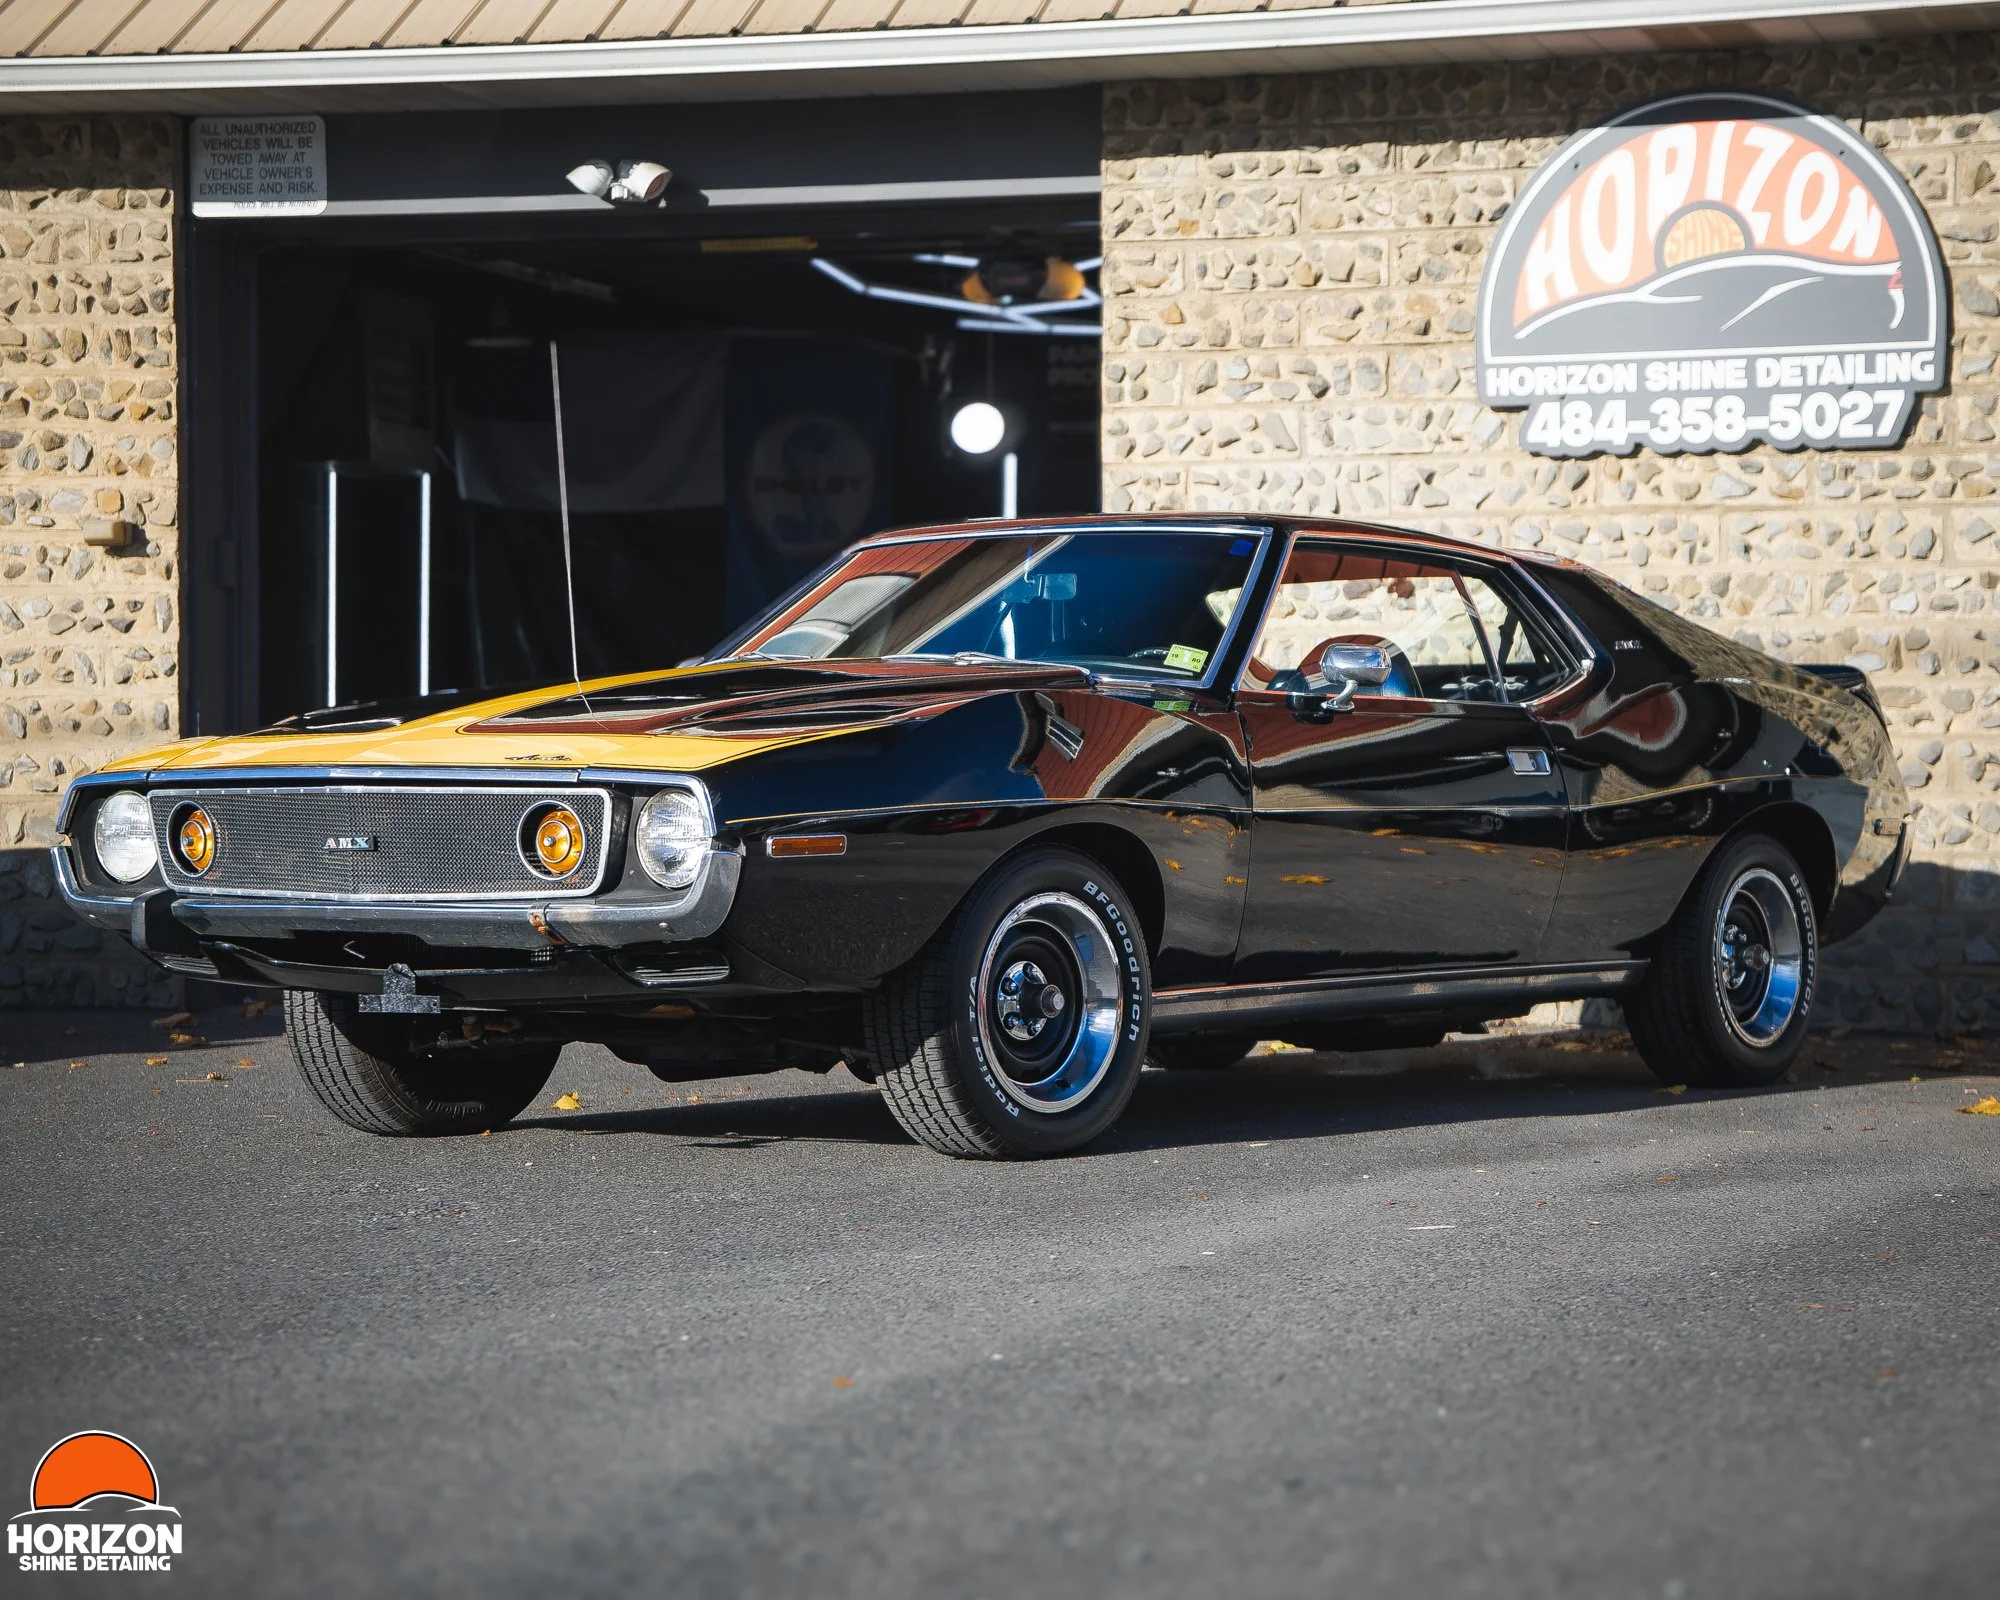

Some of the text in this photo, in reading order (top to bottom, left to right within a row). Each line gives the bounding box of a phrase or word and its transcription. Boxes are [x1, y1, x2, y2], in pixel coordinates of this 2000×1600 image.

[200, 121, 317, 136] ALL UNAUTHORIZED
[203, 136, 313, 151] VEHICLES WILL BE
[210, 151, 306, 166] TOWED AWAY AT
[204, 166, 314, 180] VEHICLE OWNER'S
[199, 182, 254, 196] EXPENSE
[258, 181, 283, 195] AND
[1525, 120, 1882, 312] HORIZON
[1664, 209, 1746, 268] SHINE
[1486, 351, 1936, 398] HORIZON SHINE DETAILING
[1526, 390, 1906, 449] 484-358-5027
[321, 837, 370, 849] AMX
[1083, 881, 1140, 1042] BFGoodrich
